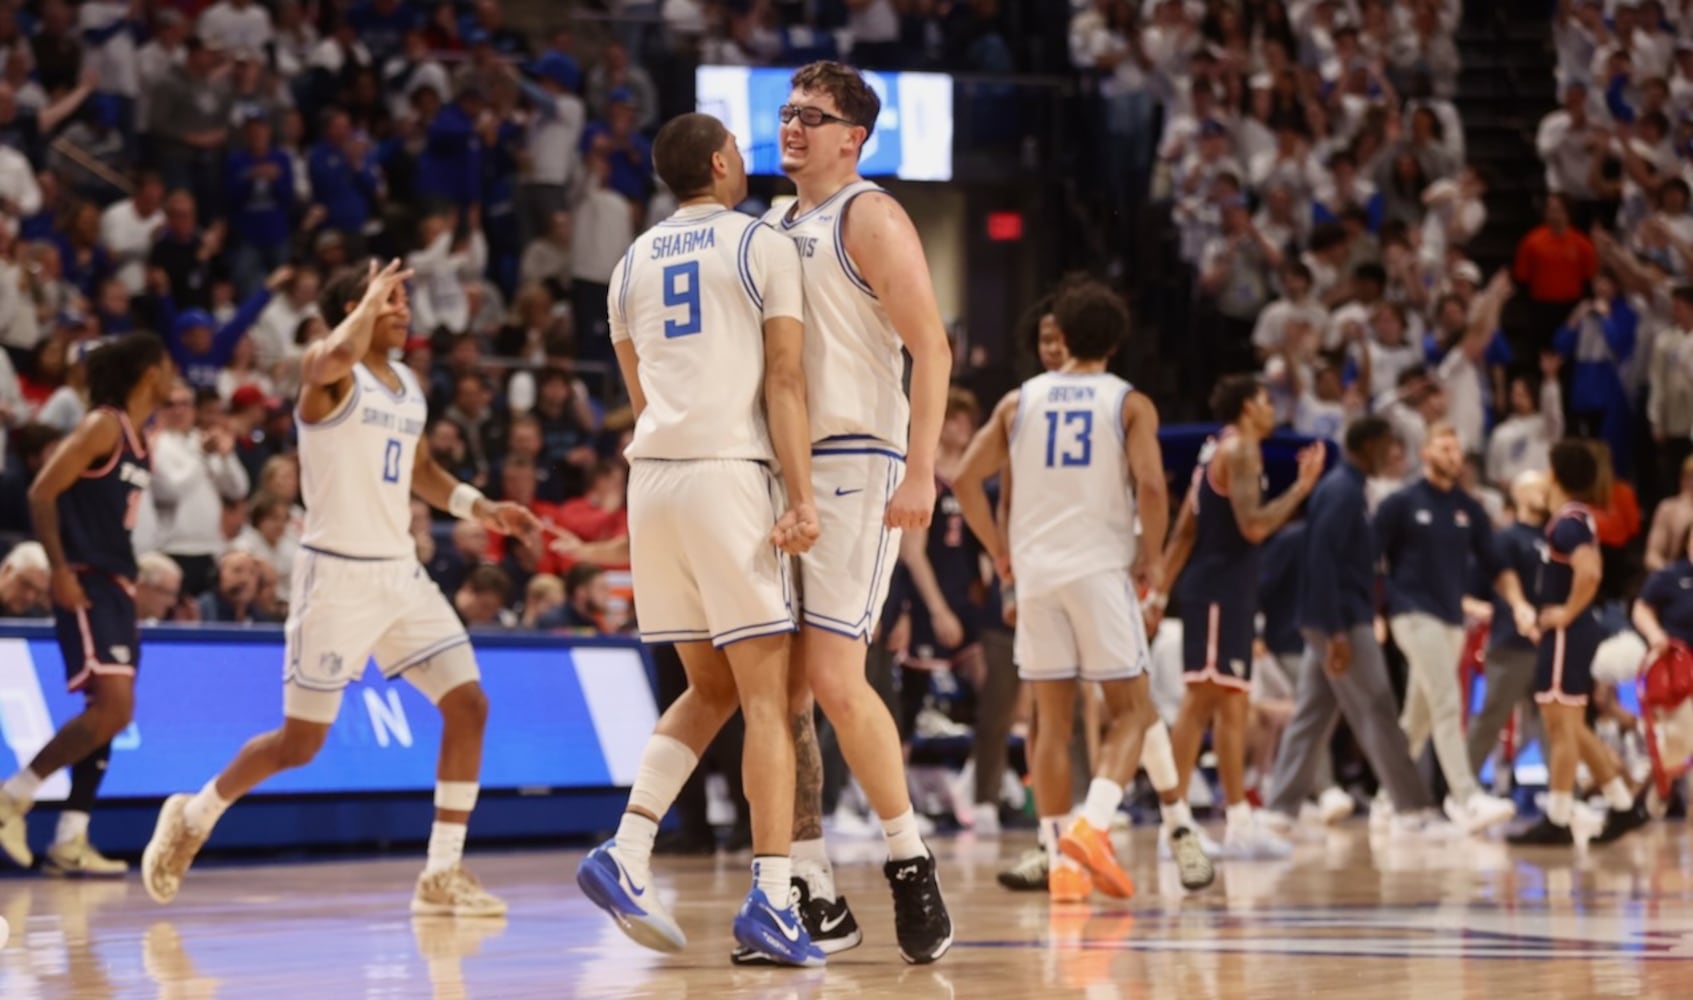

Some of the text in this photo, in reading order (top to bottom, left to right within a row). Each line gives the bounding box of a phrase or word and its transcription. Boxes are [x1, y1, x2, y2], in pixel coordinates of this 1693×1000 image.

[650, 226, 716, 260] SHARMA
[663, 260, 702, 338] 9
[361, 406, 395, 431] SAINT
[1045, 410, 1093, 467] 13
[383, 438, 403, 483] 0
